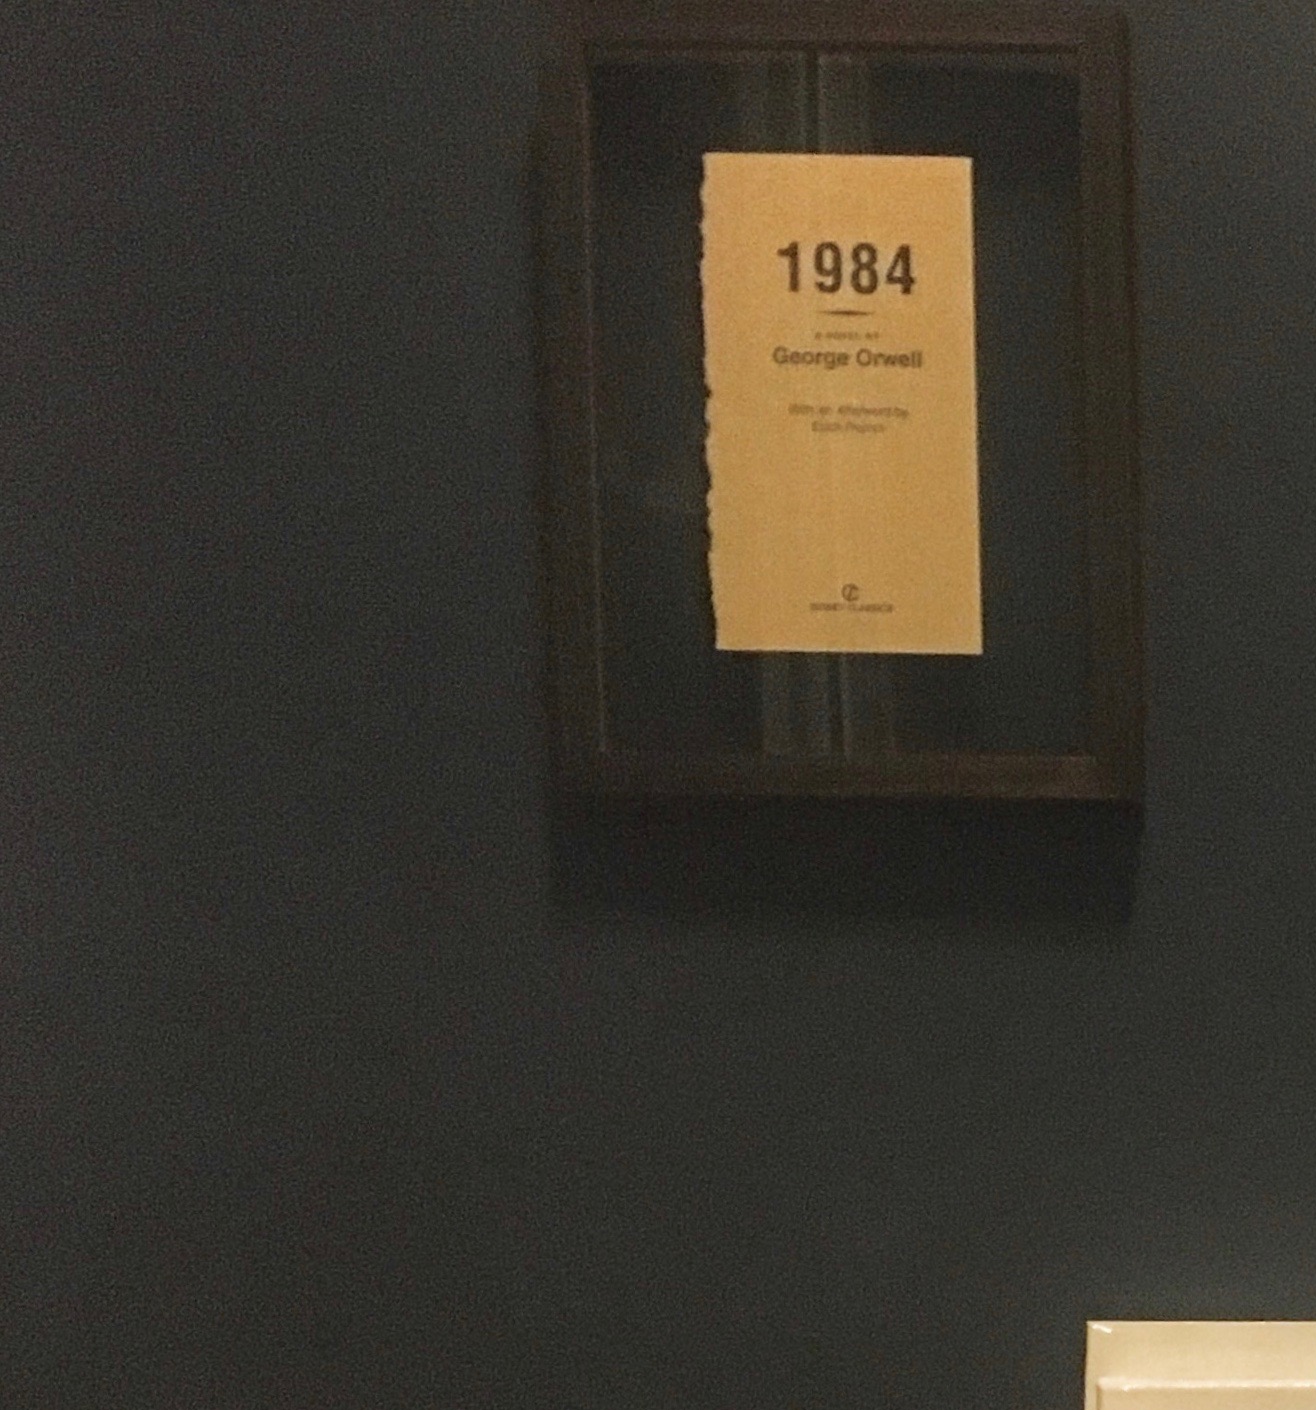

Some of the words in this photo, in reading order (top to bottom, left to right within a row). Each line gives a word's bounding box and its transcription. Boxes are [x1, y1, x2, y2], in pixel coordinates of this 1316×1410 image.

[777, 241, 916, 295] 1984
[773, 346, 850, 370] George
[856, 348, 923, 369] Orwell
